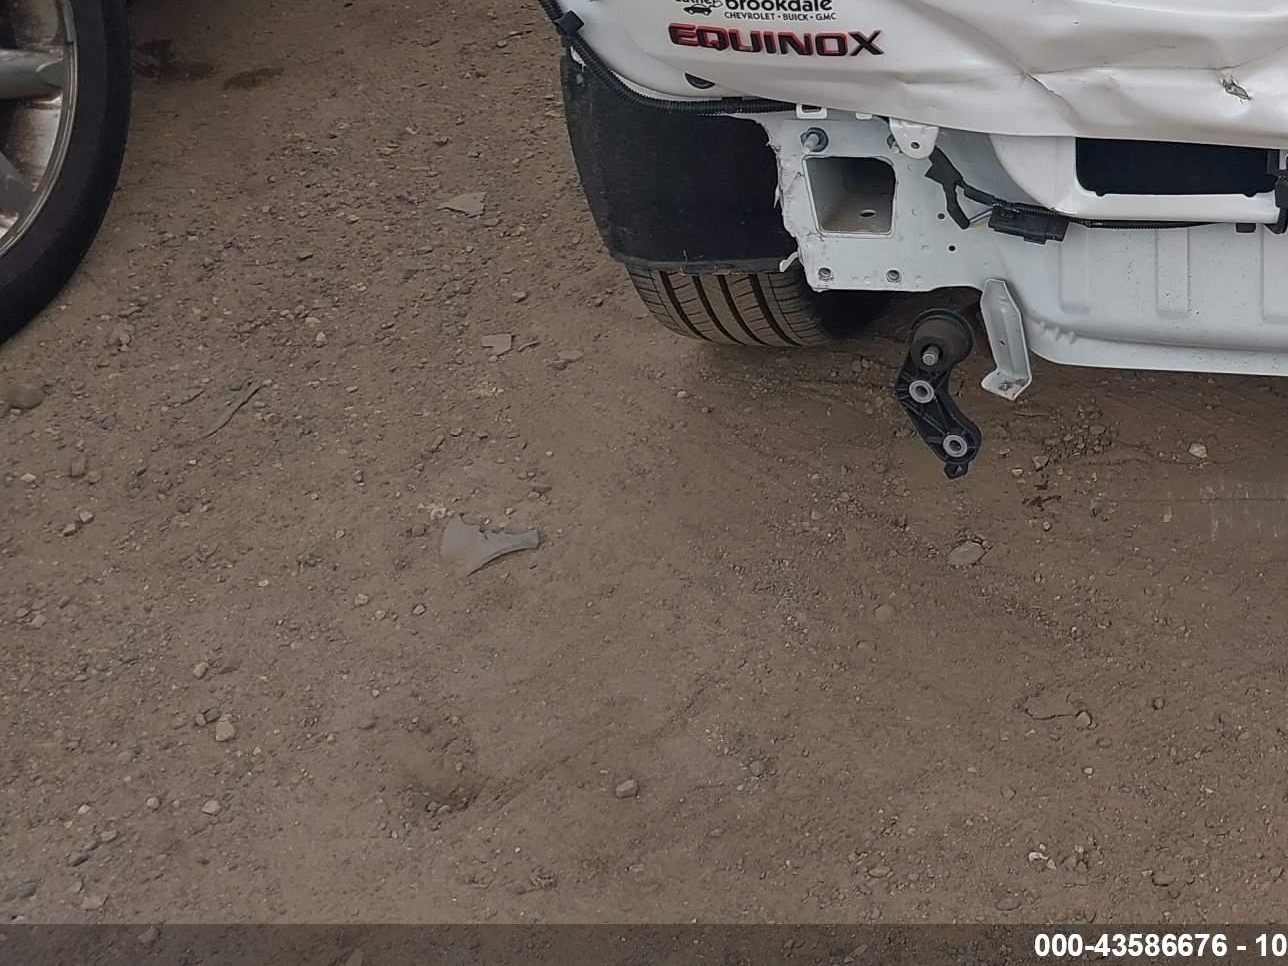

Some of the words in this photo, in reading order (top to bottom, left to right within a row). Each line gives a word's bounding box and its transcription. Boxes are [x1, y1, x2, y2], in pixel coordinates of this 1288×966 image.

[724, 12, 775, 20] CHEVROLET
[783, 13, 809, 21] BUICK
[815, 13, 837, 21] GMC
[668, 22, 884, 56] EQUINOX
